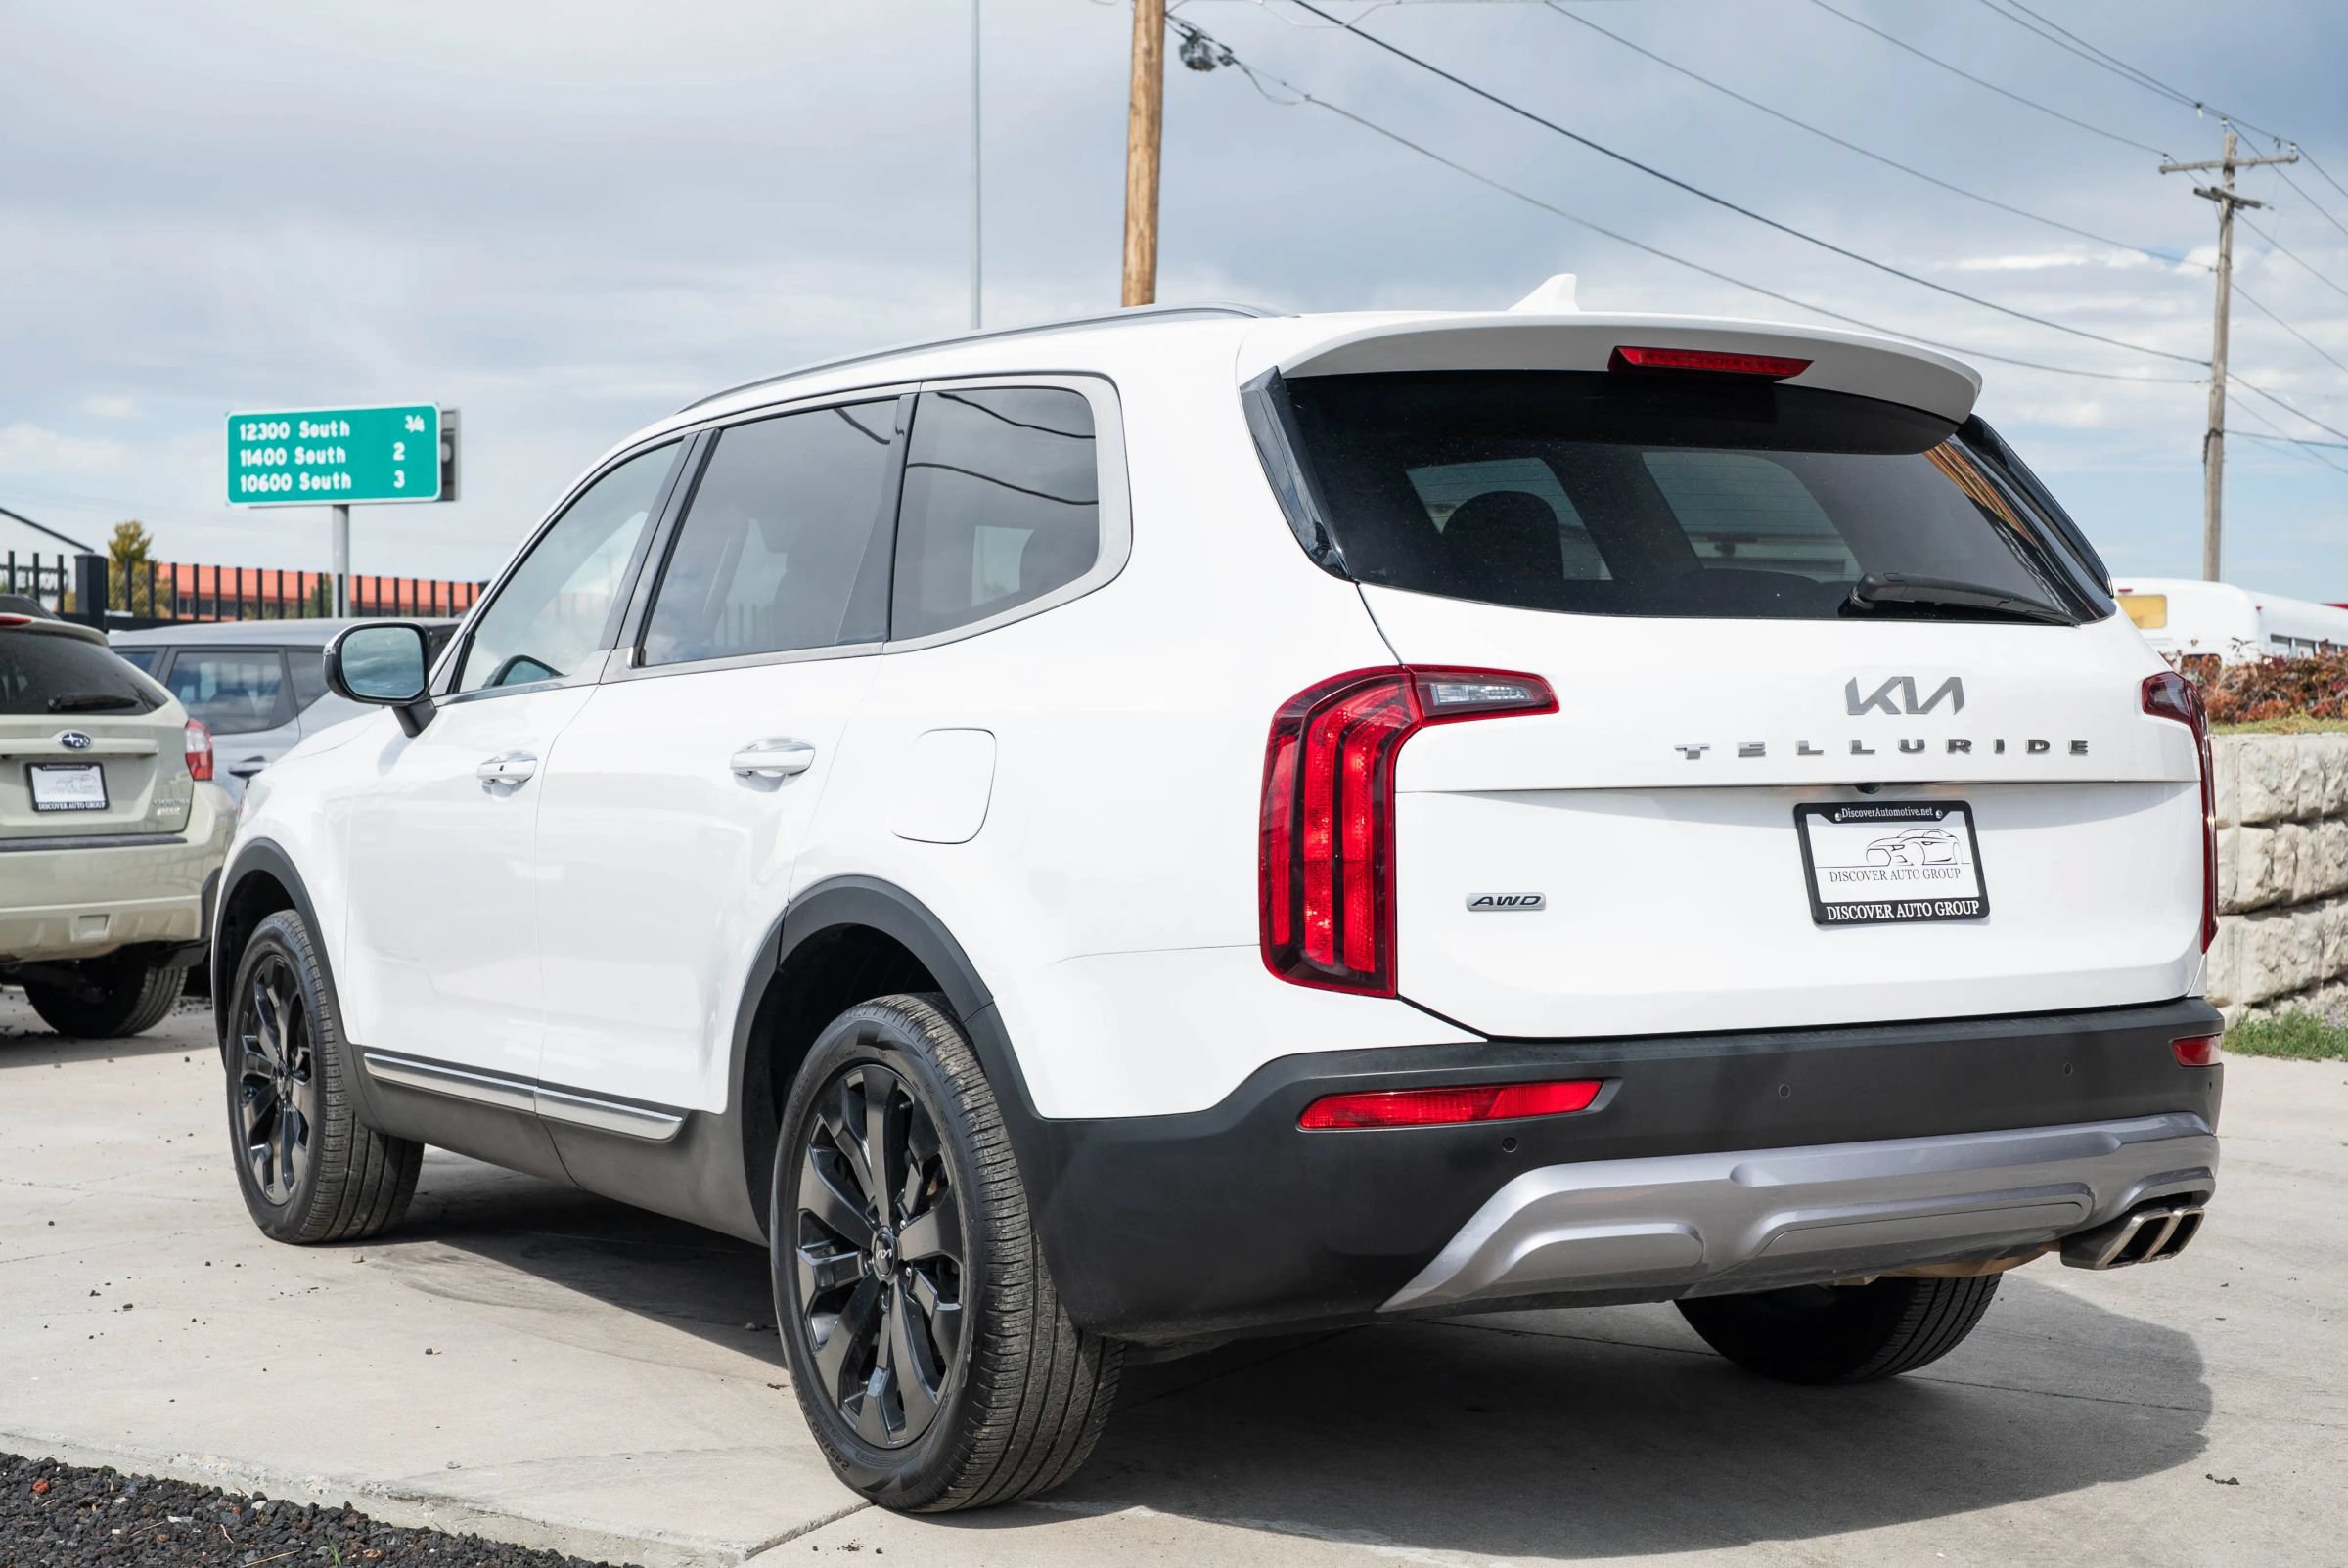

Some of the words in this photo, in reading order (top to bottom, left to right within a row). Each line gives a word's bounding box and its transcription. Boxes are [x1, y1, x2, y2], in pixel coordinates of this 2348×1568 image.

[240, 422, 290, 441] 12300
[298, 420, 350, 438] South
[240, 447, 287, 467] 11400
[294, 446, 346, 465] South
[392, 442, 405, 461] 2
[240, 473, 292, 493] 10600
[299, 472, 352, 490] South
[393, 470, 405, 488] 3
[1844, 676, 1965, 715] KIA
[1674, 739, 2089, 760] TELLURIDE
[68, 801, 85, 810] AUTO
[1841, 806, 1933, 818] DiscoverAutomotive.net
[1829, 869, 1887, 883] DISCOVER
[1890, 869, 1920, 881] AUTO
[1922, 867, 1961, 879] GROUP
[1471, 895, 1542, 907] AWD
[1826, 903, 1895, 920] DISCOVER
[1896, 902, 1933, 918] AUTO
[1935, 900, 1980, 916] GROUP
